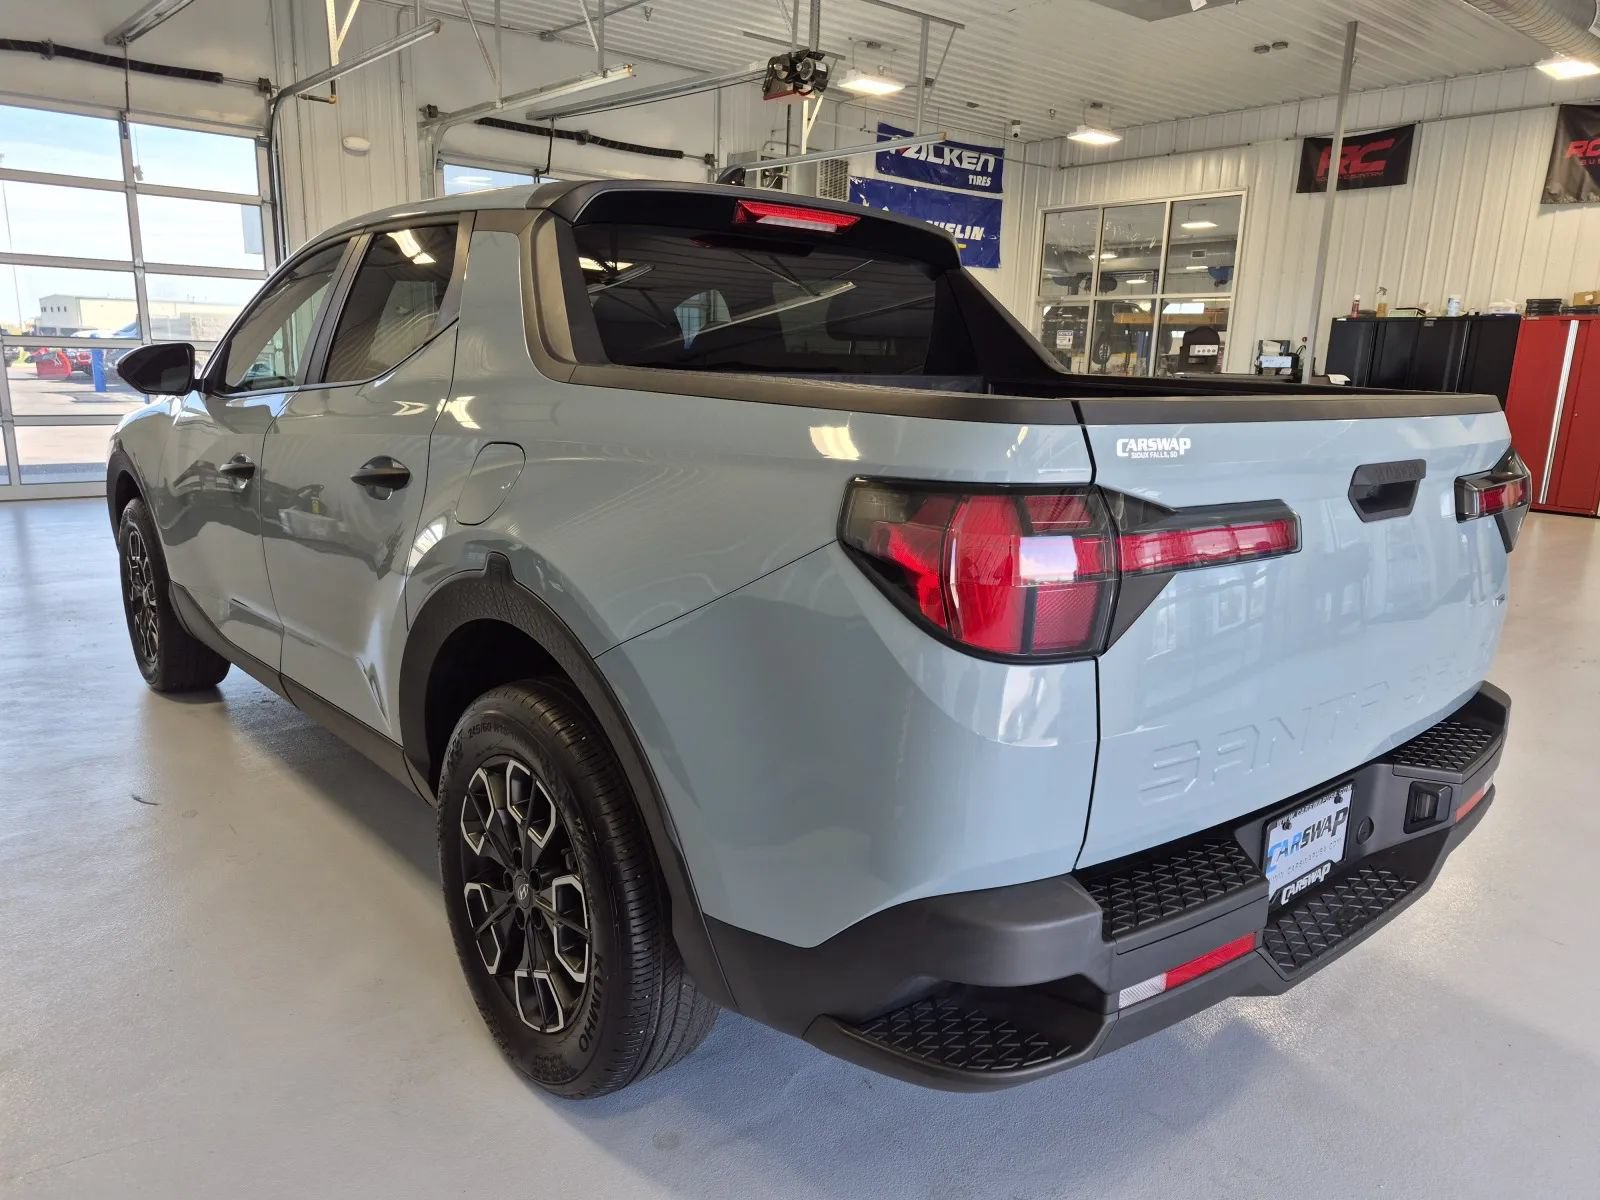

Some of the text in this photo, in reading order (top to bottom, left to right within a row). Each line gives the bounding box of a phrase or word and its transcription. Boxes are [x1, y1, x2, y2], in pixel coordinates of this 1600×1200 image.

[968, 174, 992, 187] TIRES
[1116, 437, 1192, 457] CARSWAP
[1264, 806, 1349, 874] CARSWAP
[1280, 862, 1332, 906] CARSWAP
[578, 952, 603, 1053] KUMHO
